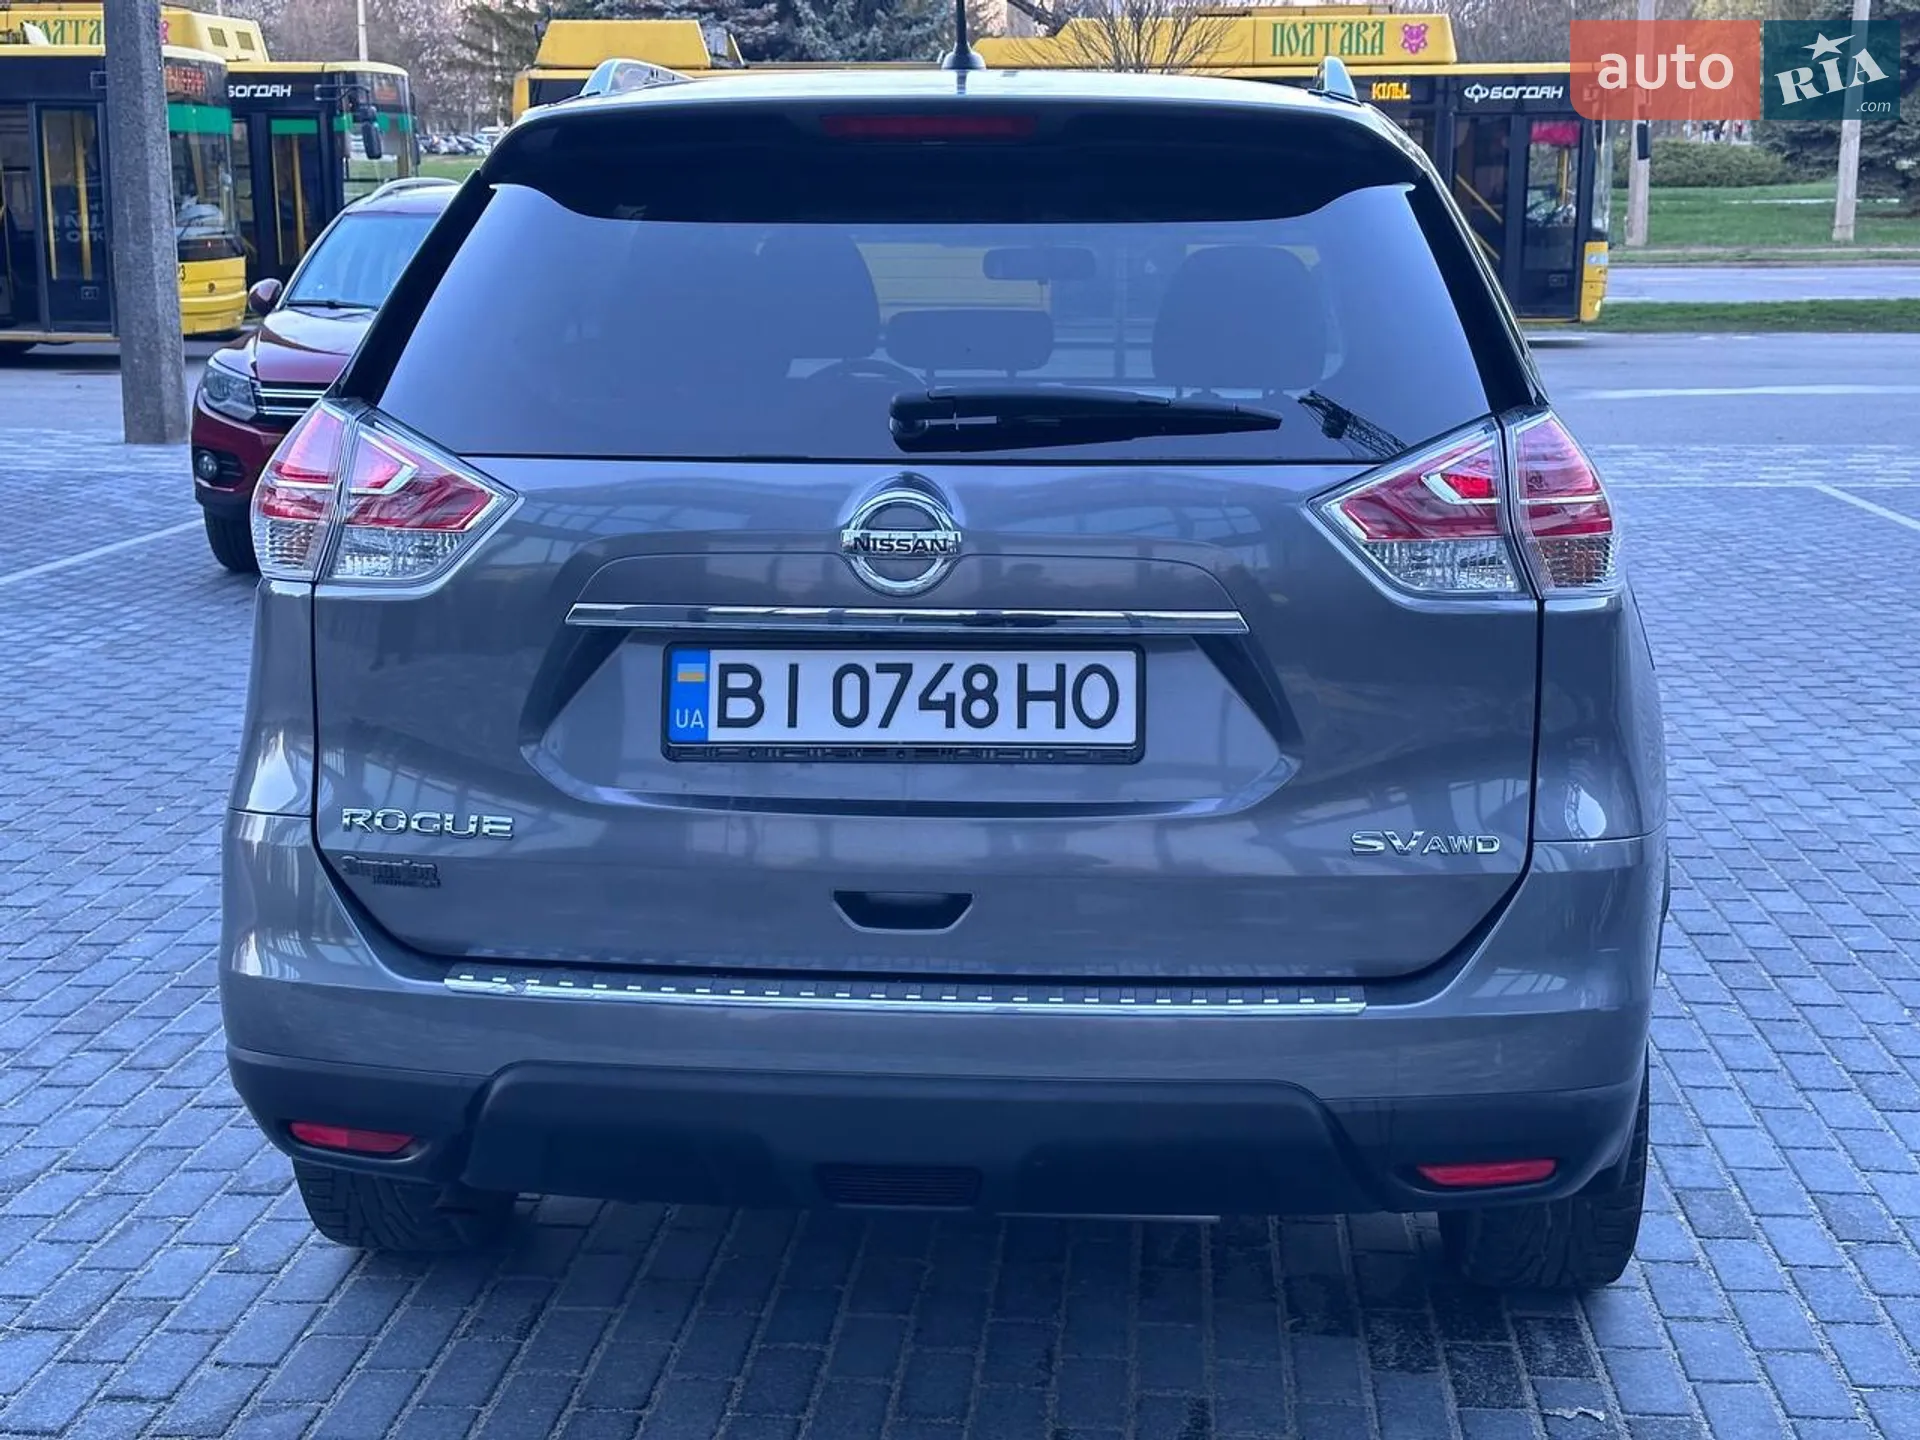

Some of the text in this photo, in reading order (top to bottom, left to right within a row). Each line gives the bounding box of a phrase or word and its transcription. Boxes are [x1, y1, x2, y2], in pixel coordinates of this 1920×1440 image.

[1271, 21, 1385, 57] ПОЛТАВА
[1489, 86, 1564, 99] БОГДАН
[853, 536, 948, 552] NISSAN
[716, 663, 799, 729] BI
[832, 663, 999, 730] 0748
[676, 708, 705, 729] UA
[341, 807, 514, 840] ROGUE
[1351, 830, 1501, 856] SV AWD
